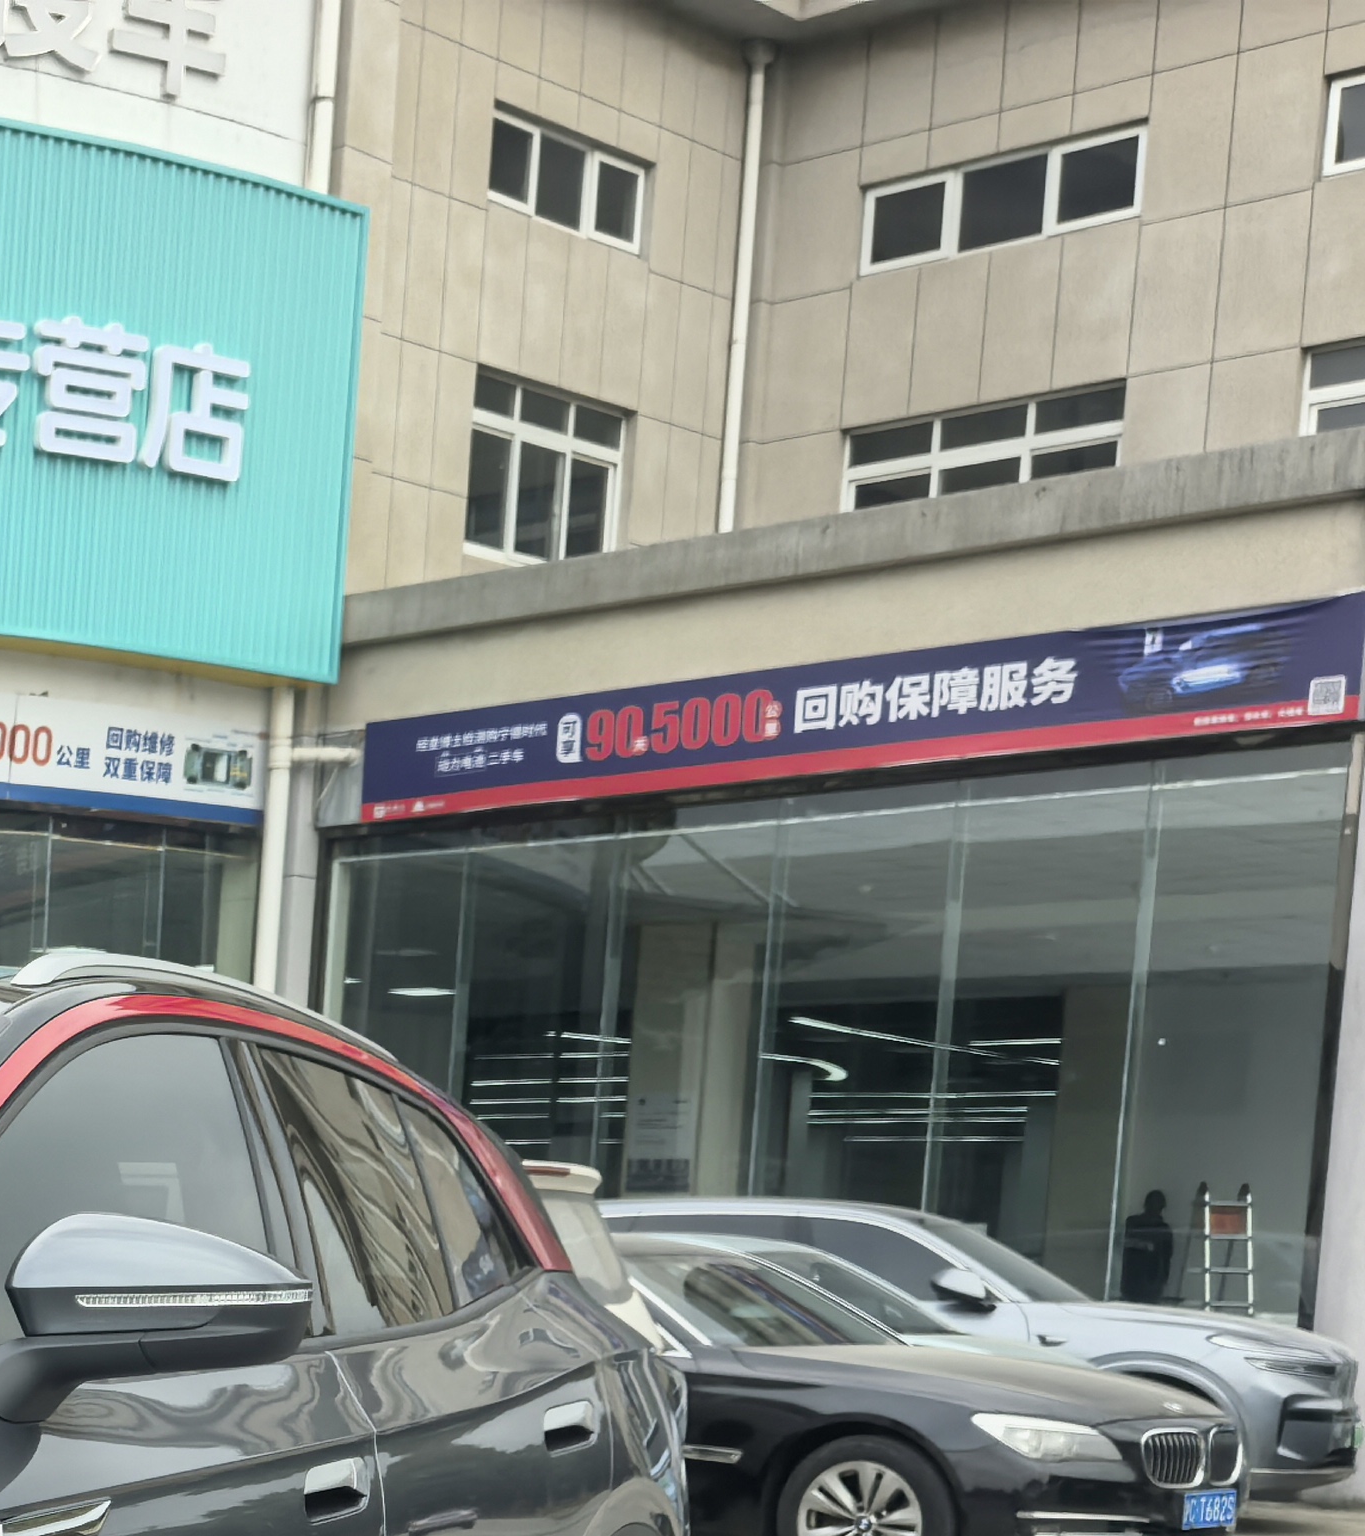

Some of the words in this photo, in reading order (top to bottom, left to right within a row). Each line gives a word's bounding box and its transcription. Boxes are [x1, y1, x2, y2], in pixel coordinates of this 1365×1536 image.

[793, 655, 1079, 735] 回购保障服务
[105, 726, 176, 757] 回购维修
[102, 756, 174, 786] 双重保障
